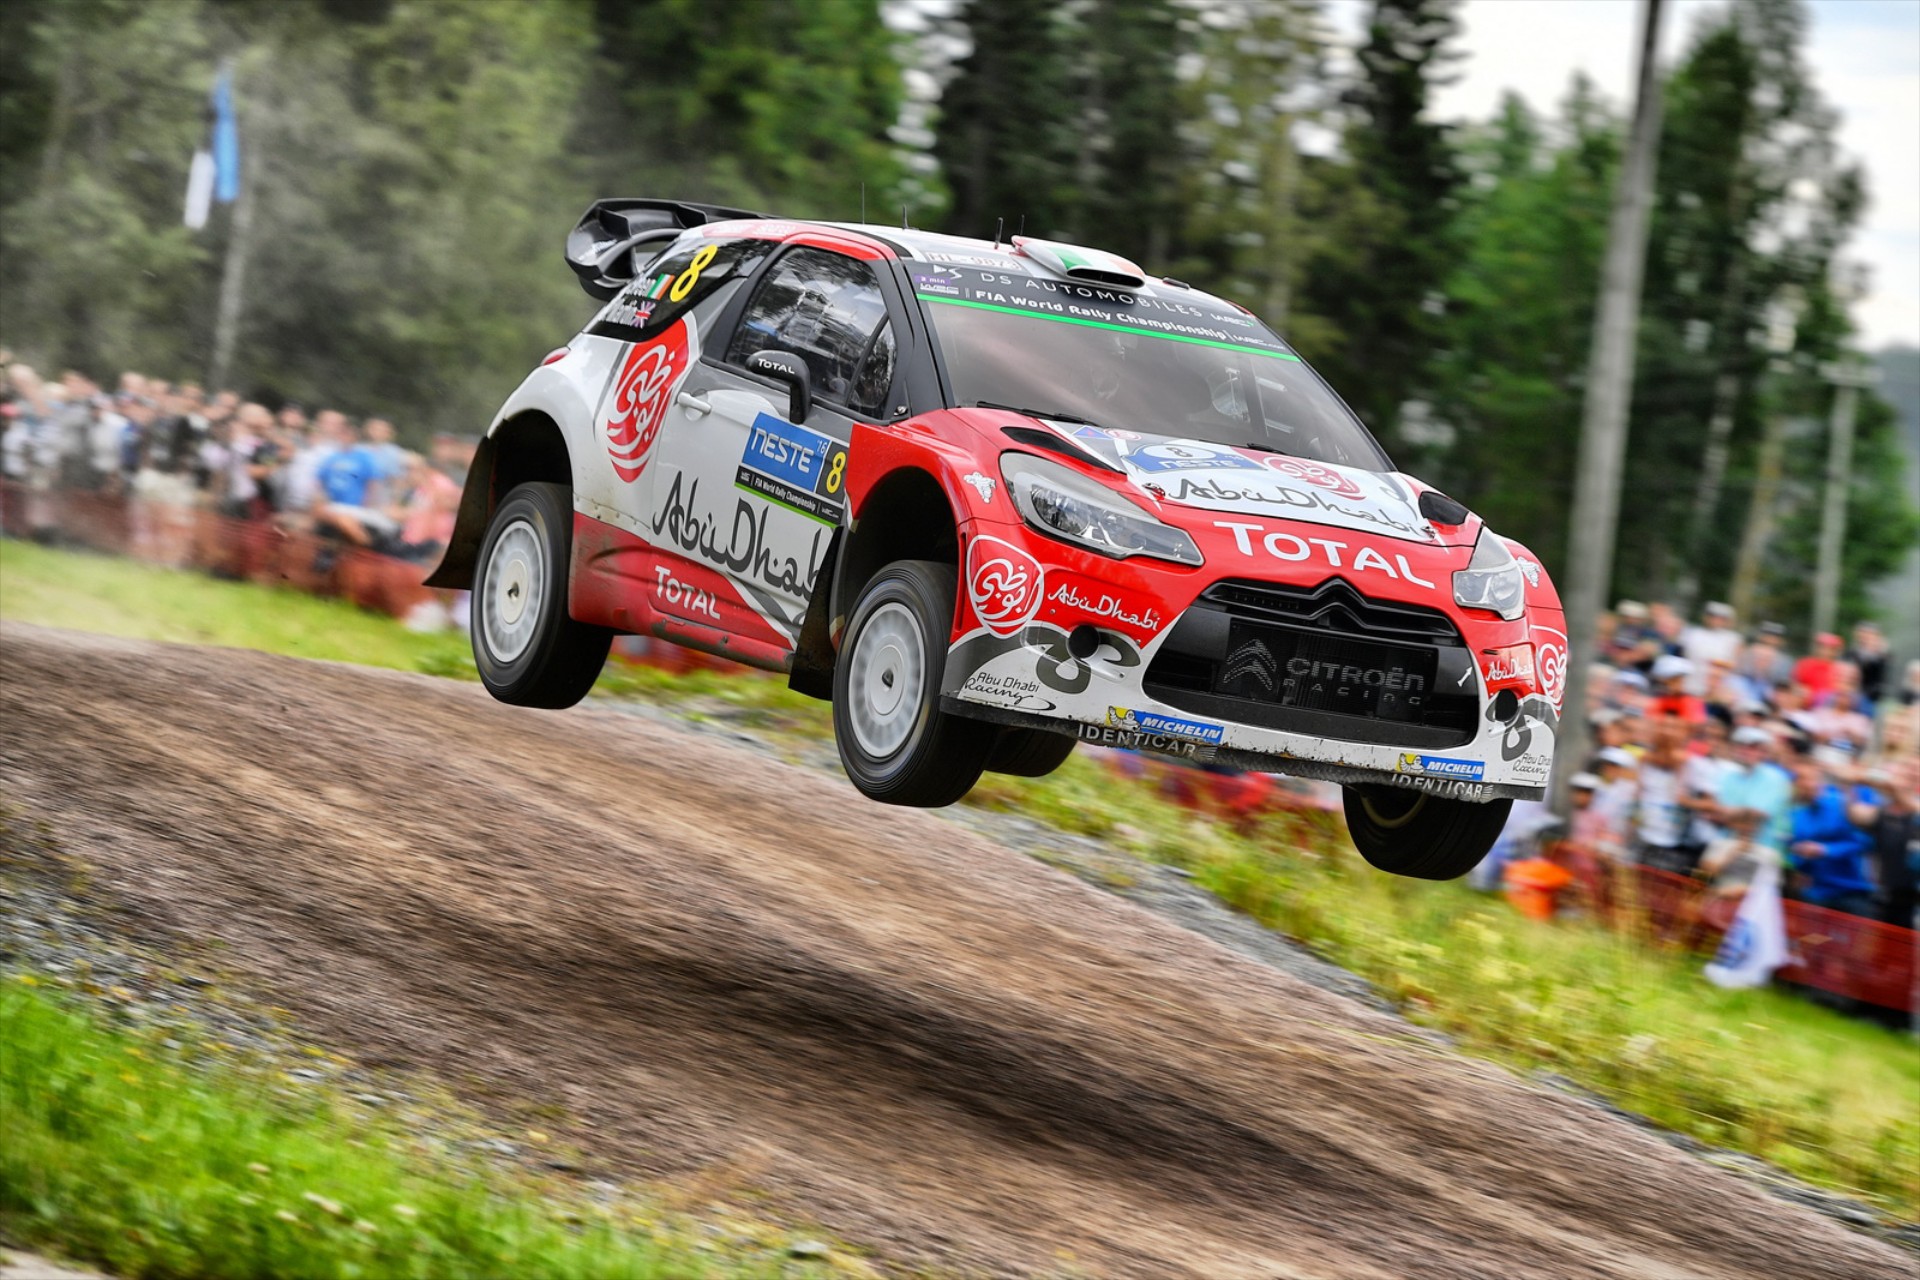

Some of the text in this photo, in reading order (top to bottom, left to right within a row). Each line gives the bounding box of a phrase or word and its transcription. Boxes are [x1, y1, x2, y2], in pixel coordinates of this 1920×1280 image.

[670, 244, 718, 302] 8
[980, 273, 1203, 317] DS AUTOMOBILES
[976, 290, 1007, 303] FIA
[1010, 296, 1063, 312] World
[1068, 305, 1112, 321] Rally
[1116, 312, 1228, 341] Championship
[758, 358, 796, 375] TOTAL
[751, 427, 815, 474] NESTE
[1158, 460, 1241, 469] NESTE
[1165, 446, 1194, 458] 8
[826, 451, 847, 494] 8
[754, 477, 763, 488] FIA
[762, 481, 776, 494] World
[775, 486, 787, 500] Rally
[786, 491, 816, 512] Championship
[1213, 520, 1436, 590] TOTAL
[655, 565, 721, 620] TOTAL
[964, 677, 1034, 705] Racing
[976, 671, 1041, 693] Abu Dhabi
[1078, 722, 1197, 758] IDENTICAR
[1141, 717, 1221, 740] MICHELIN
[1391, 773, 1483, 798] IDENTICAR
[1426, 761, 1484, 775] MICHELIN
